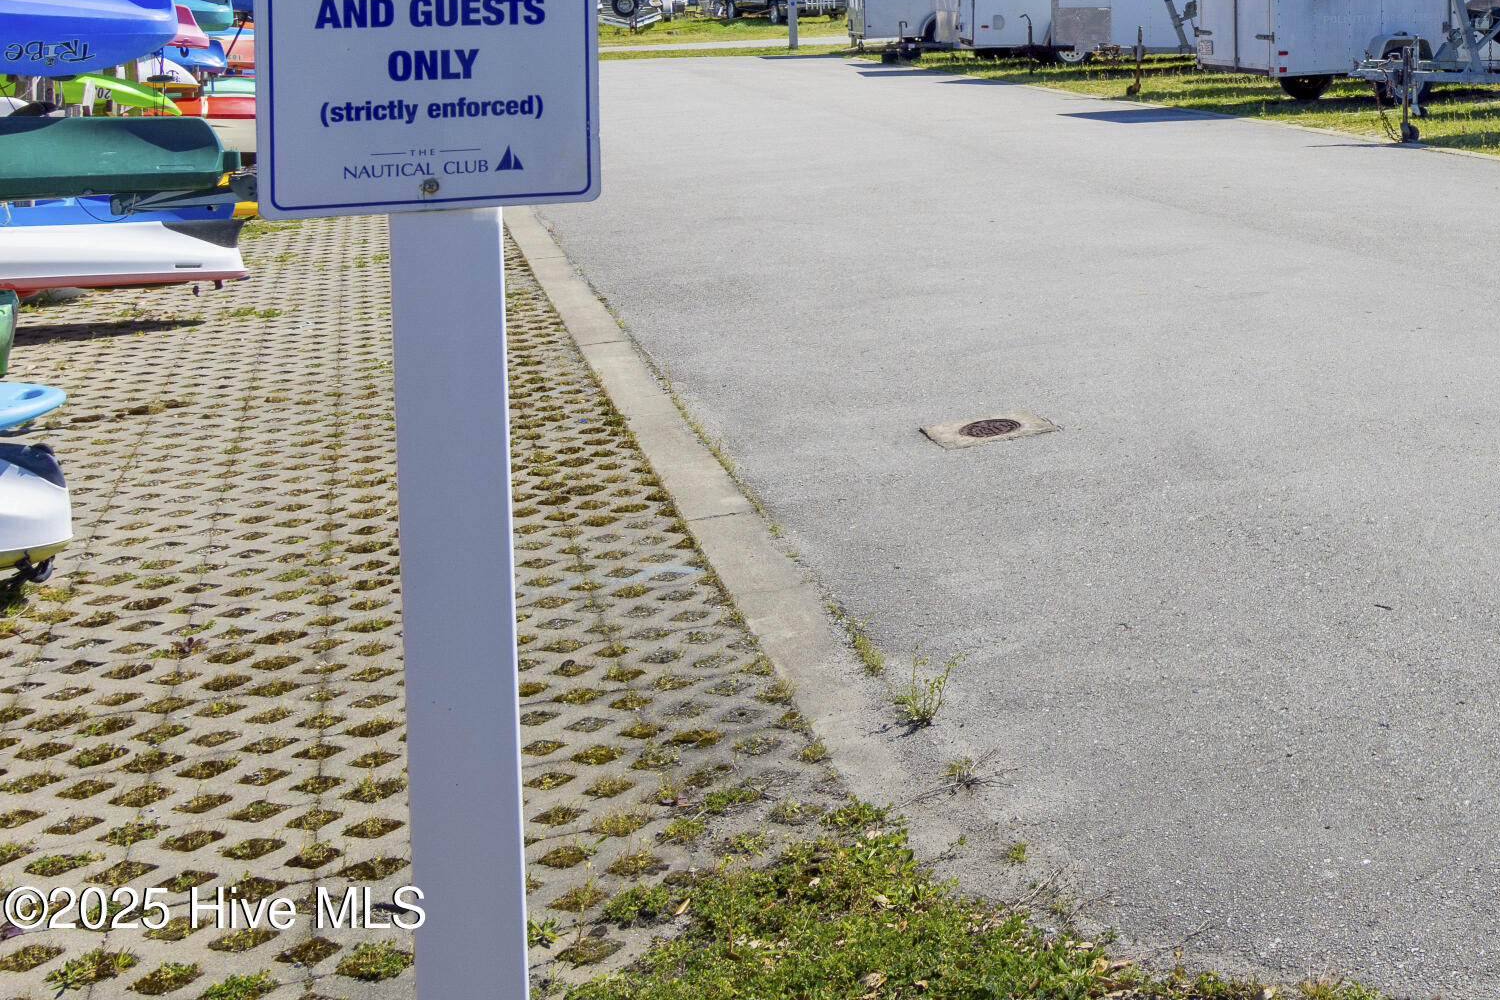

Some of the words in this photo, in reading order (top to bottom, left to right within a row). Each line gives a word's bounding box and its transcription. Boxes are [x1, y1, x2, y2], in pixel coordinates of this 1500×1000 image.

[387, 49, 480, 82] ONLY
[320, 100, 419, 127] (strictly
[427, 95, 544, 120] enforced)
[410, 149, 436, 157] THE
[343, 163, 435, 180] NAUTICAL
[443, 160, 489, 175] CLUB
